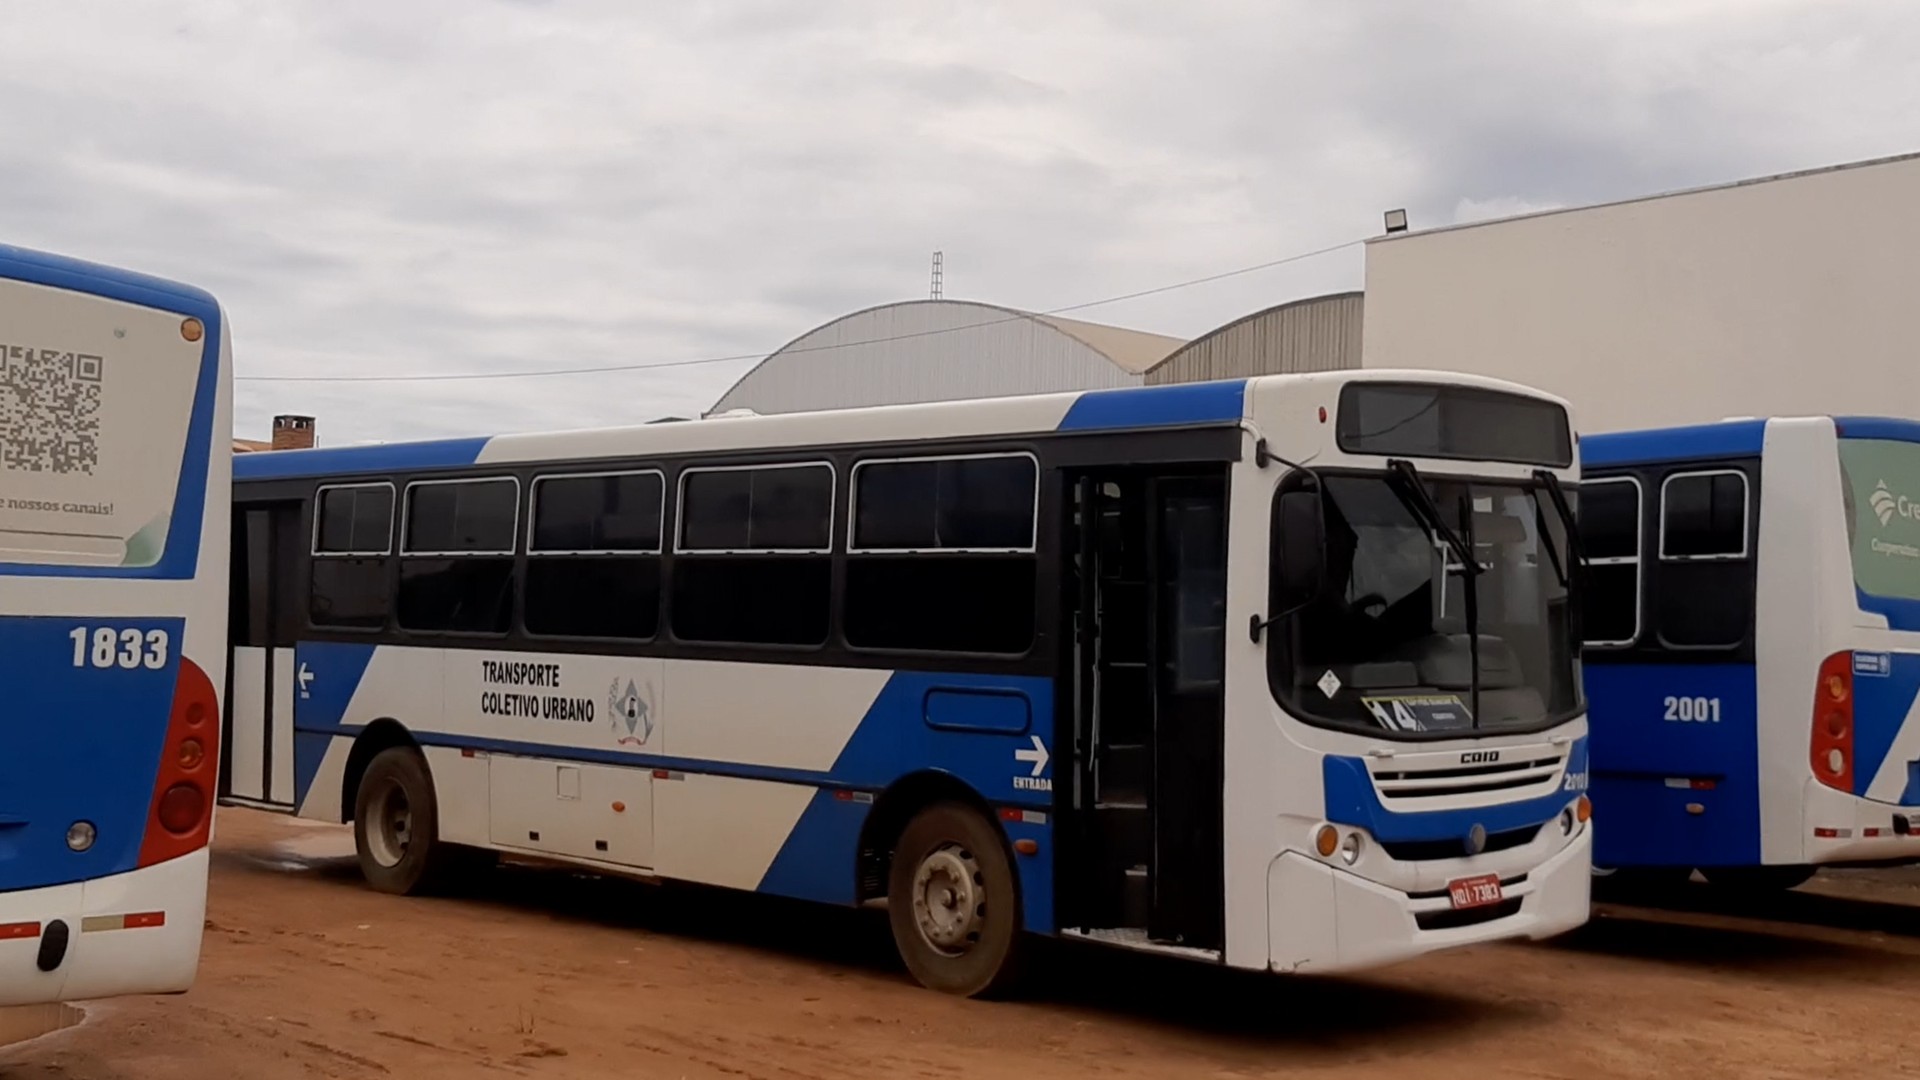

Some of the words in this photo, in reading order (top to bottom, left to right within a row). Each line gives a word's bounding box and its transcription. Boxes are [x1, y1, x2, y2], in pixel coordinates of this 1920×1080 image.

[8, 498, 60, 511] nossos
[62, 502, 114, 515] canais!
[69, 626, 168, 669] 1833
[483, 660, 559, 688] TRANSPORTE
[481, 692, 538, 718] COLETIVO
[542, 696, 595, 722] URBANO
[1664, 696, 1720, 722] 2001
[1013, 776, 1053, 791] ENTRADA
